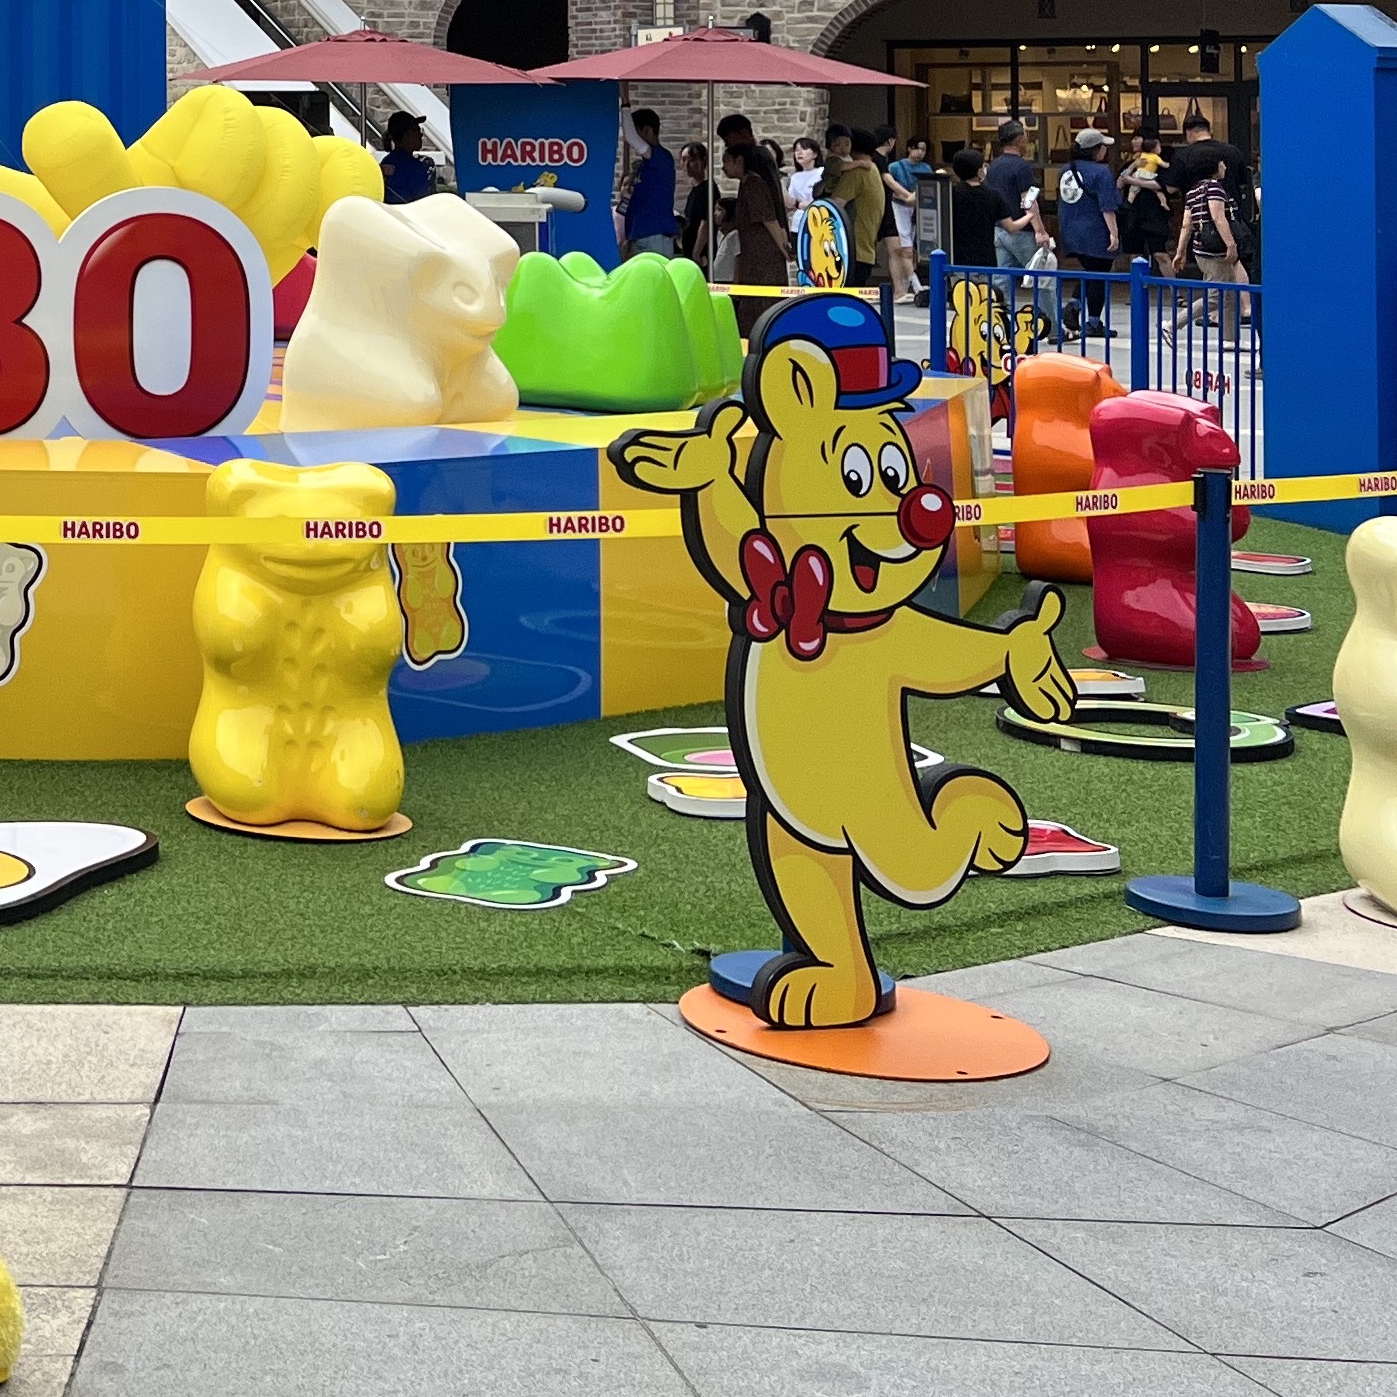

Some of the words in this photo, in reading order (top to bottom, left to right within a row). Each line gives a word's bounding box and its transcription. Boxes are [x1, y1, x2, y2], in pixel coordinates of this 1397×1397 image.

[479, 139, 586, 165] HARIBO
[1234, 483, 1276, 501] HARIBO
[1358, 476, 1397, 493] HARIBO
[1075, 493, 1118, 513] HARIBO
[61, 520, 140, 540] HARIBO
[304, 520, 383, 539] HARIBO
[547, 515, 626, 535] HARIBO
